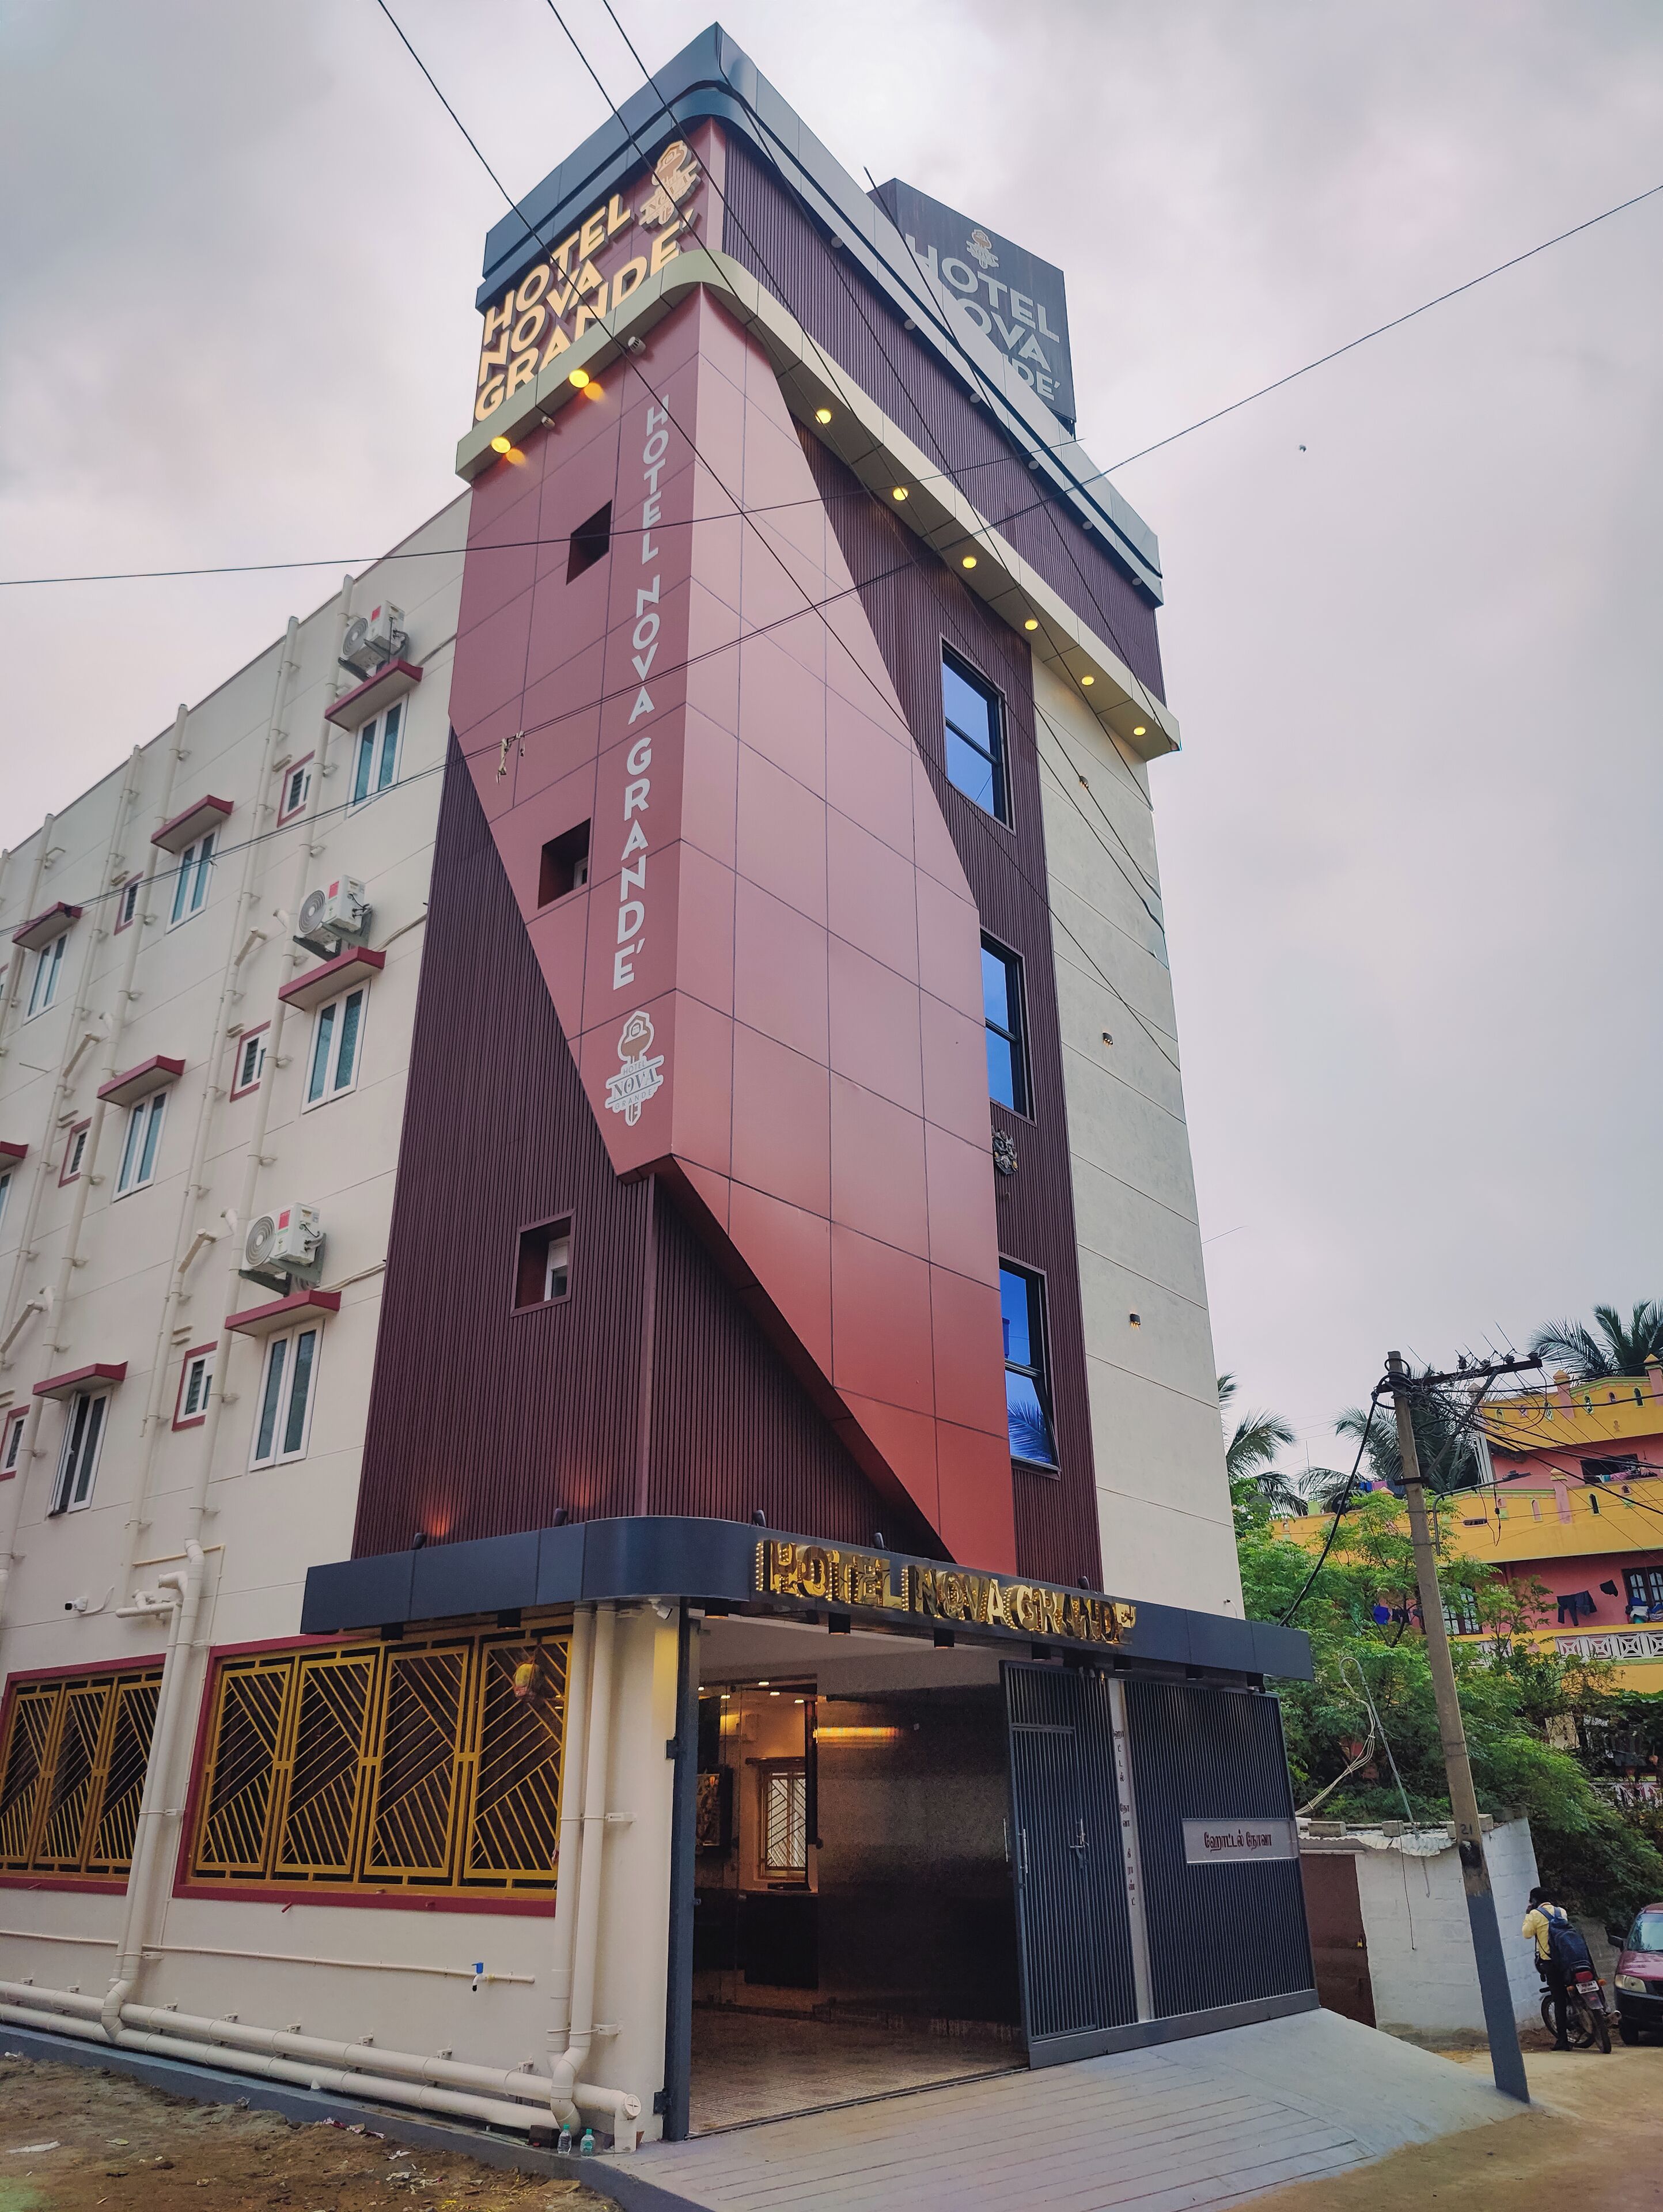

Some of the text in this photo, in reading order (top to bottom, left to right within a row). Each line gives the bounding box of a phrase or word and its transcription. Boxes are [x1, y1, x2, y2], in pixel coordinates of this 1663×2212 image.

[484, 194, 632, 346] HOTEL
[906, 233, 1060, 343] HOTEL
[479, 260, 605, 387] NOVA
[957, 298, 1052, 373] OVA
[642, 395, 669, 565] HOTEL
[628, 575, 660, 725] NOVA
[623, 1060, 645, 1075] HOTEL
[756, 1539, 903, 1608] HOTEL
[902, 1565, 1007, 1626] NOVA
[1204, 1829, 1272, 1853] ஹோட்டல் நோவா
[1460, 1824, 1473, 1835] 21
